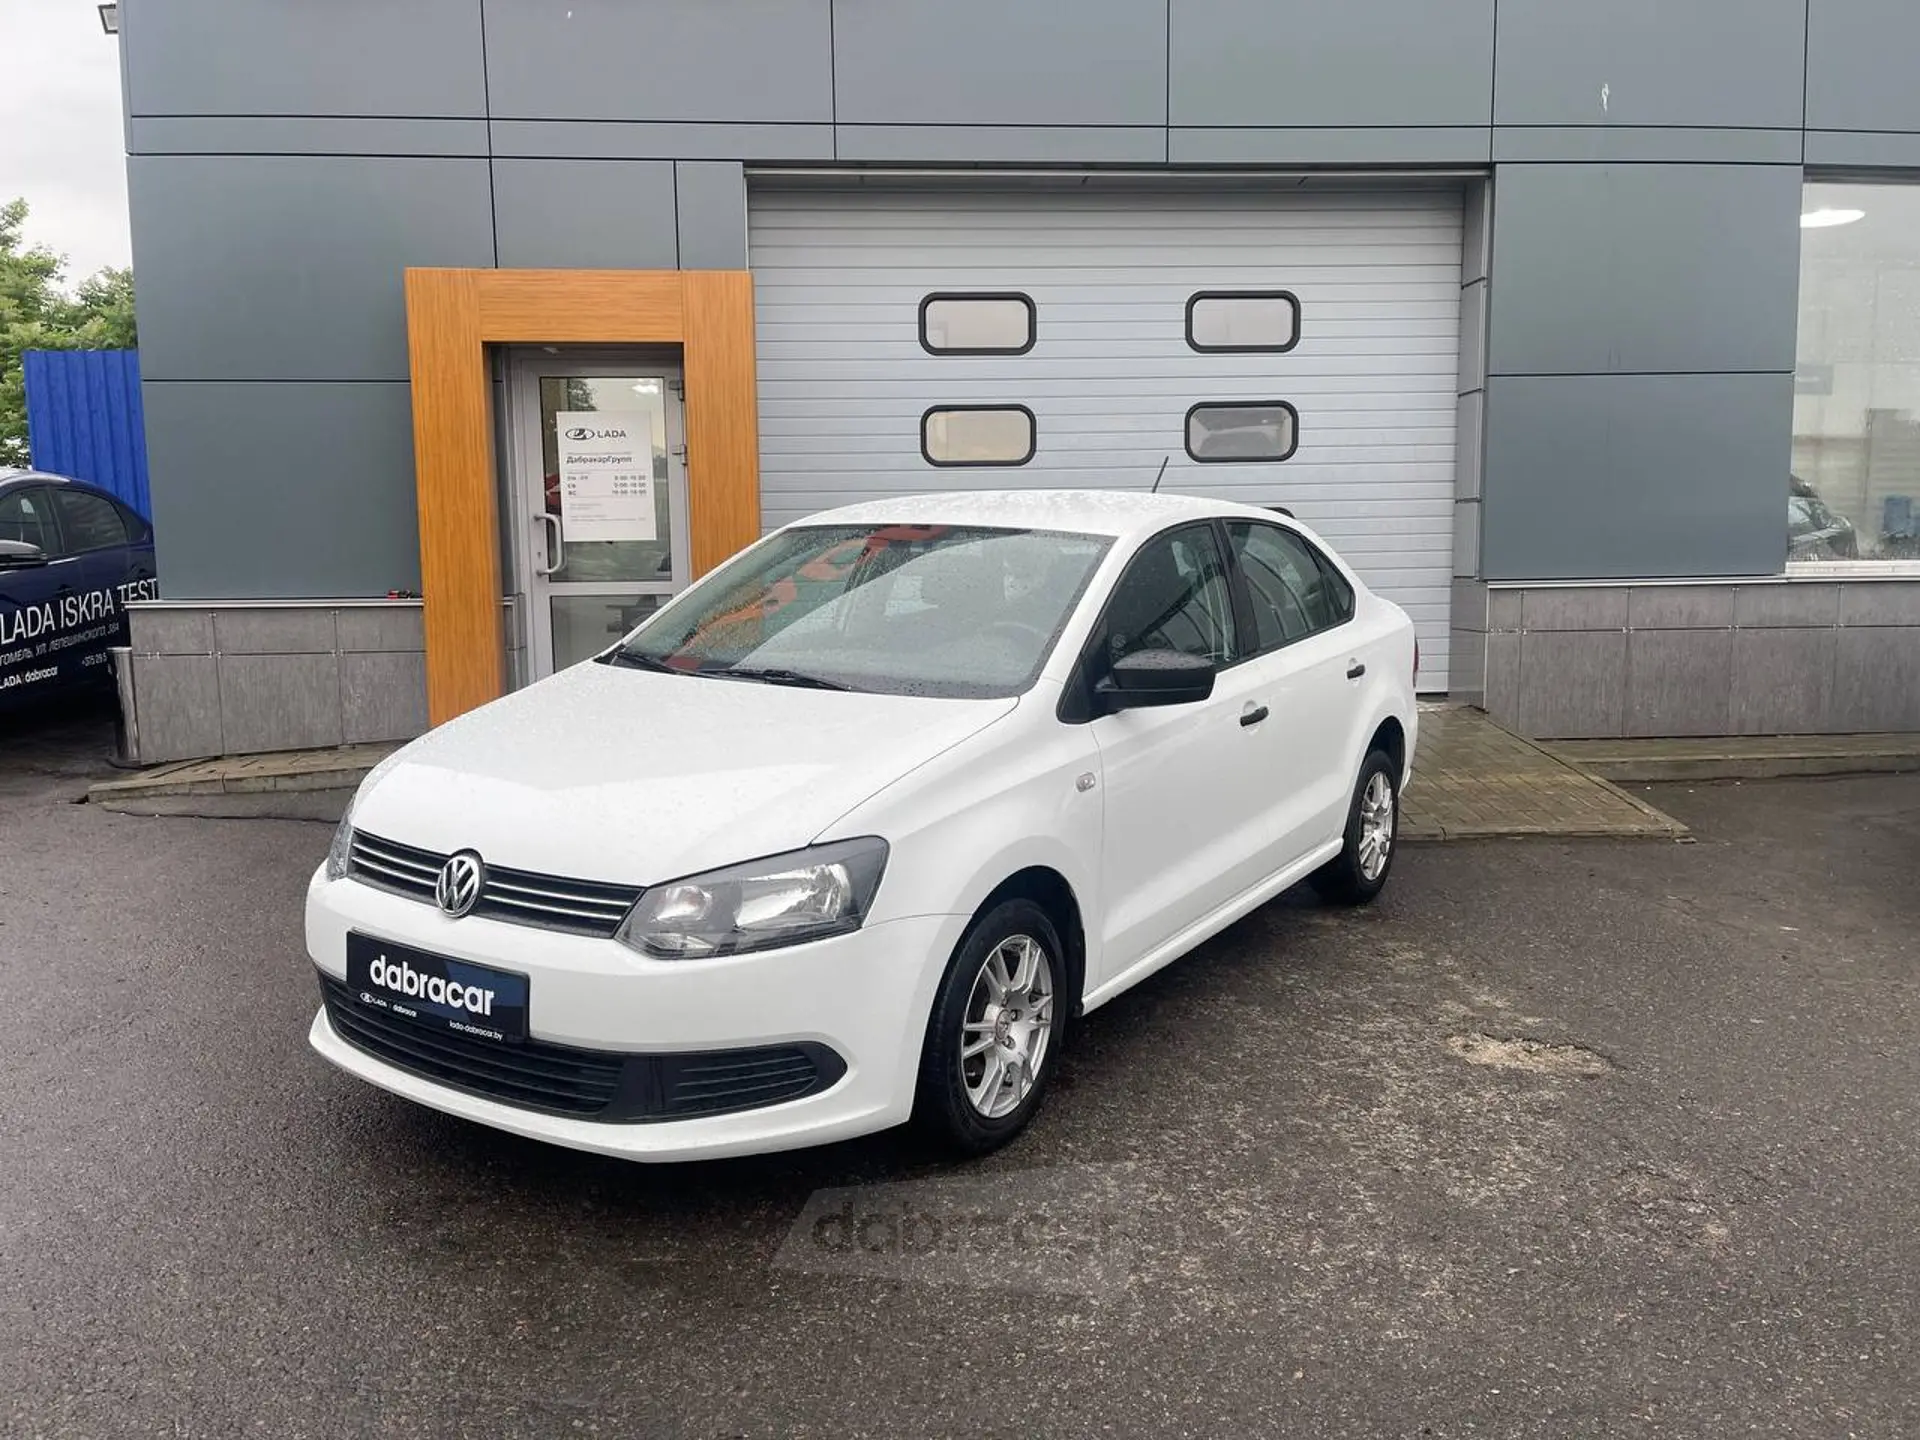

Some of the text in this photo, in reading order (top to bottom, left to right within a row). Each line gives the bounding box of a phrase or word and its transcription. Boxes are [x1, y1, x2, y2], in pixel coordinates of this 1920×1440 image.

[597, 430, 627, 439] LADA
[0, 602, 56, 645] LADA
[60, 588, 115, 629] ISKRA
[369, 954, 495, 1016] dabracar
